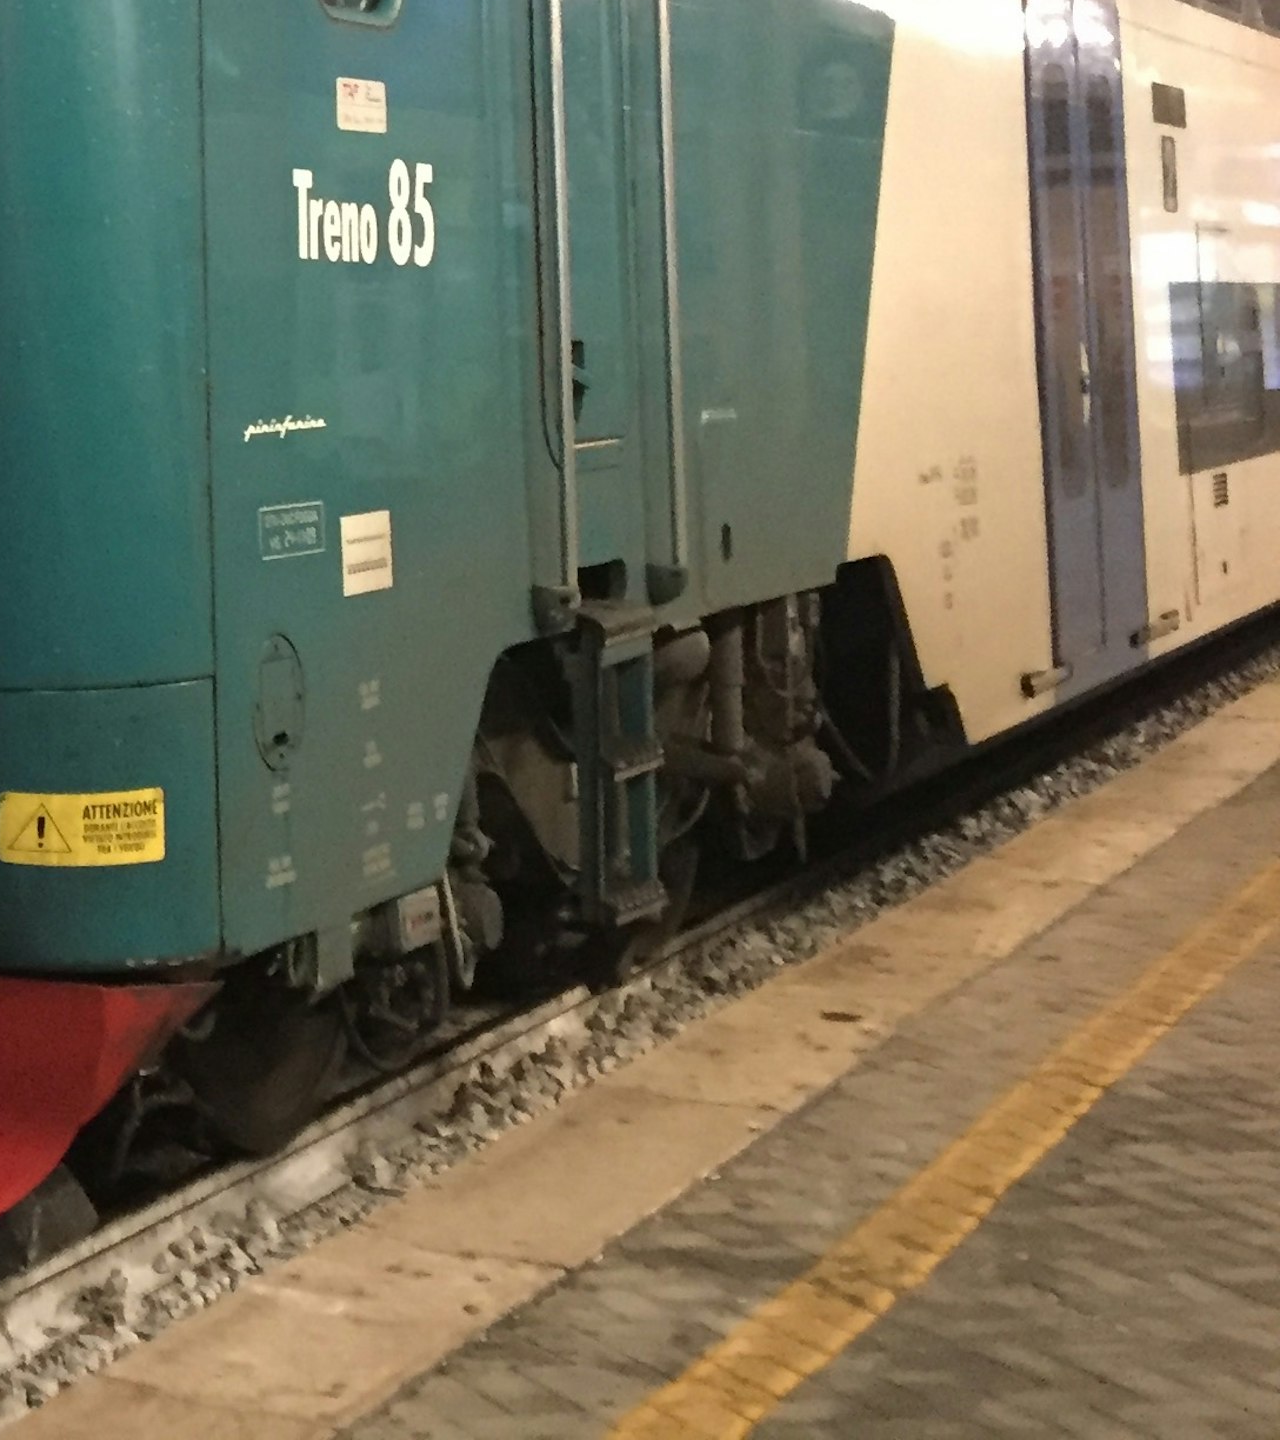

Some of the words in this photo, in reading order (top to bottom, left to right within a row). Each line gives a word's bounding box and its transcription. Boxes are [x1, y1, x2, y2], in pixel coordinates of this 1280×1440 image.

[292, 168, 378, 265] Treno
[387, 158, 435, 267] 85
[243, 414, 327, 442] pininfarina
[82, 799, 158, 820] ATTENZIONE
